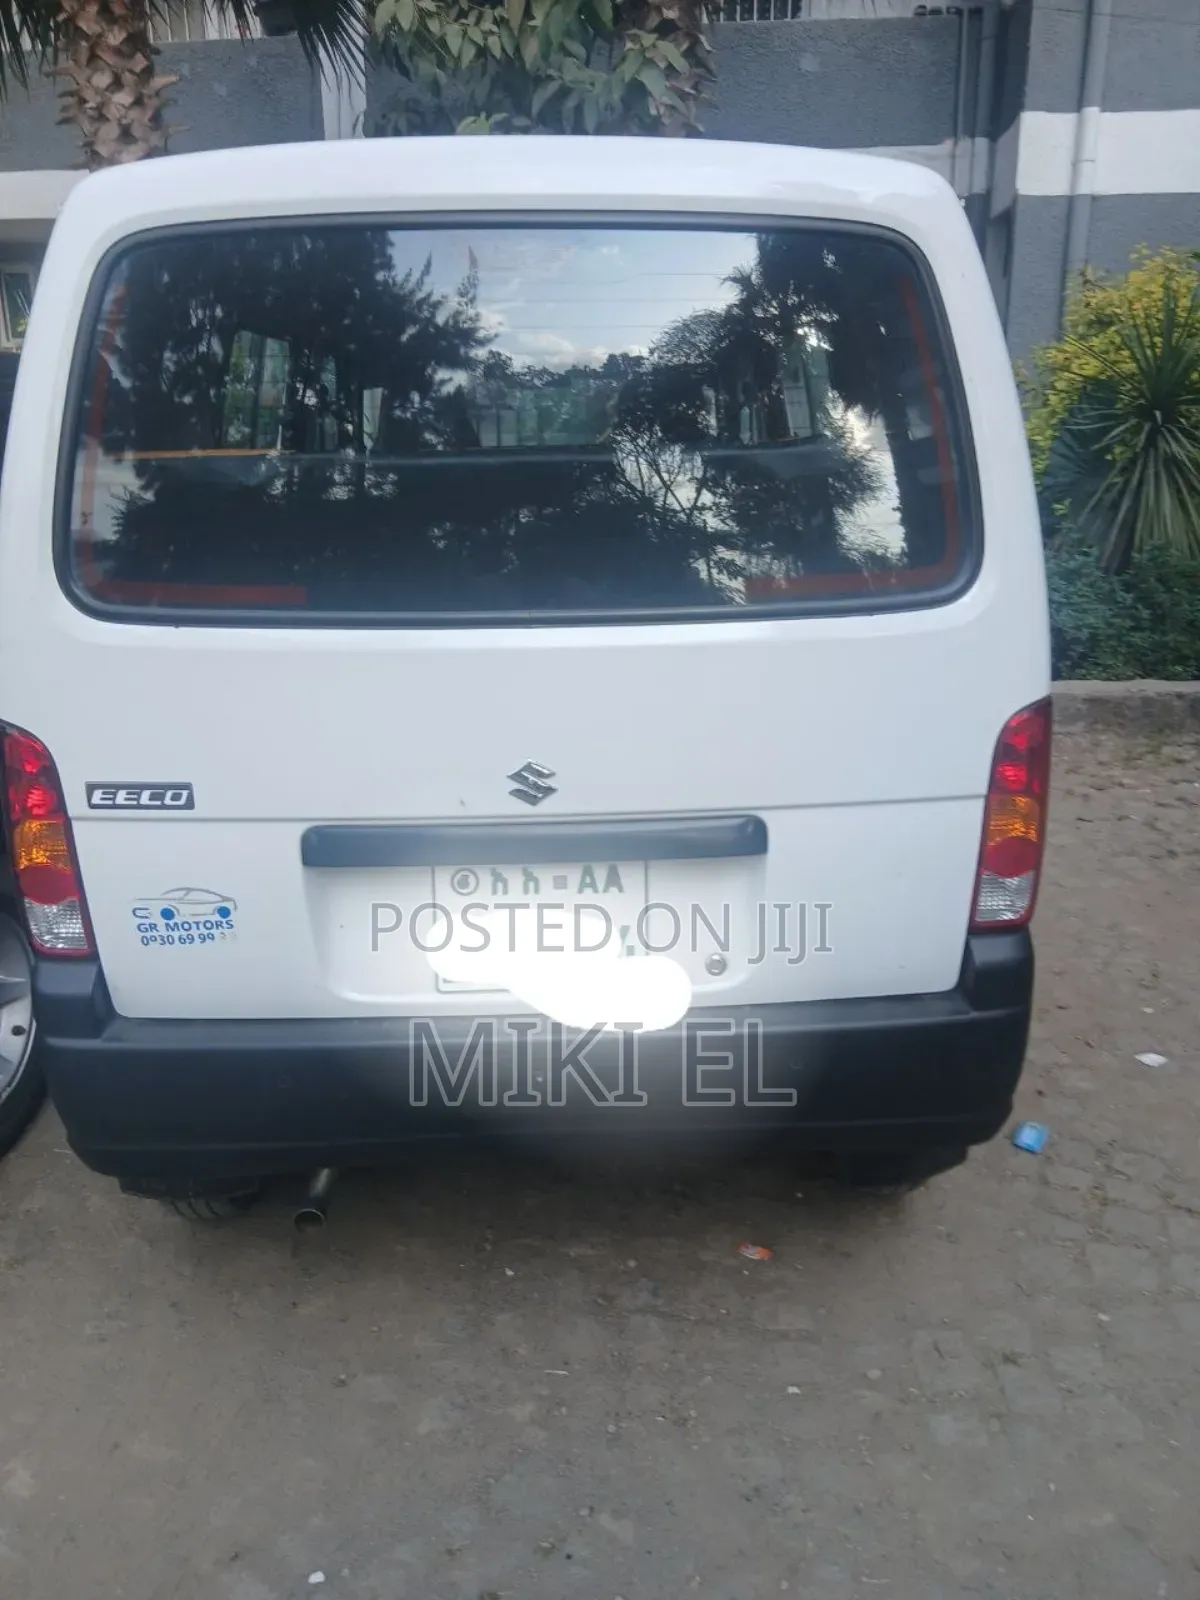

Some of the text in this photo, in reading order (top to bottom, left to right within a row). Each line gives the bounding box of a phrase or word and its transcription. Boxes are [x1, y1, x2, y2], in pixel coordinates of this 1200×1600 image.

[91, 789, 190, 805] EECO
[136, 919, 235, 934] GR MOTORS
[178, 933, 196, 945] 69
